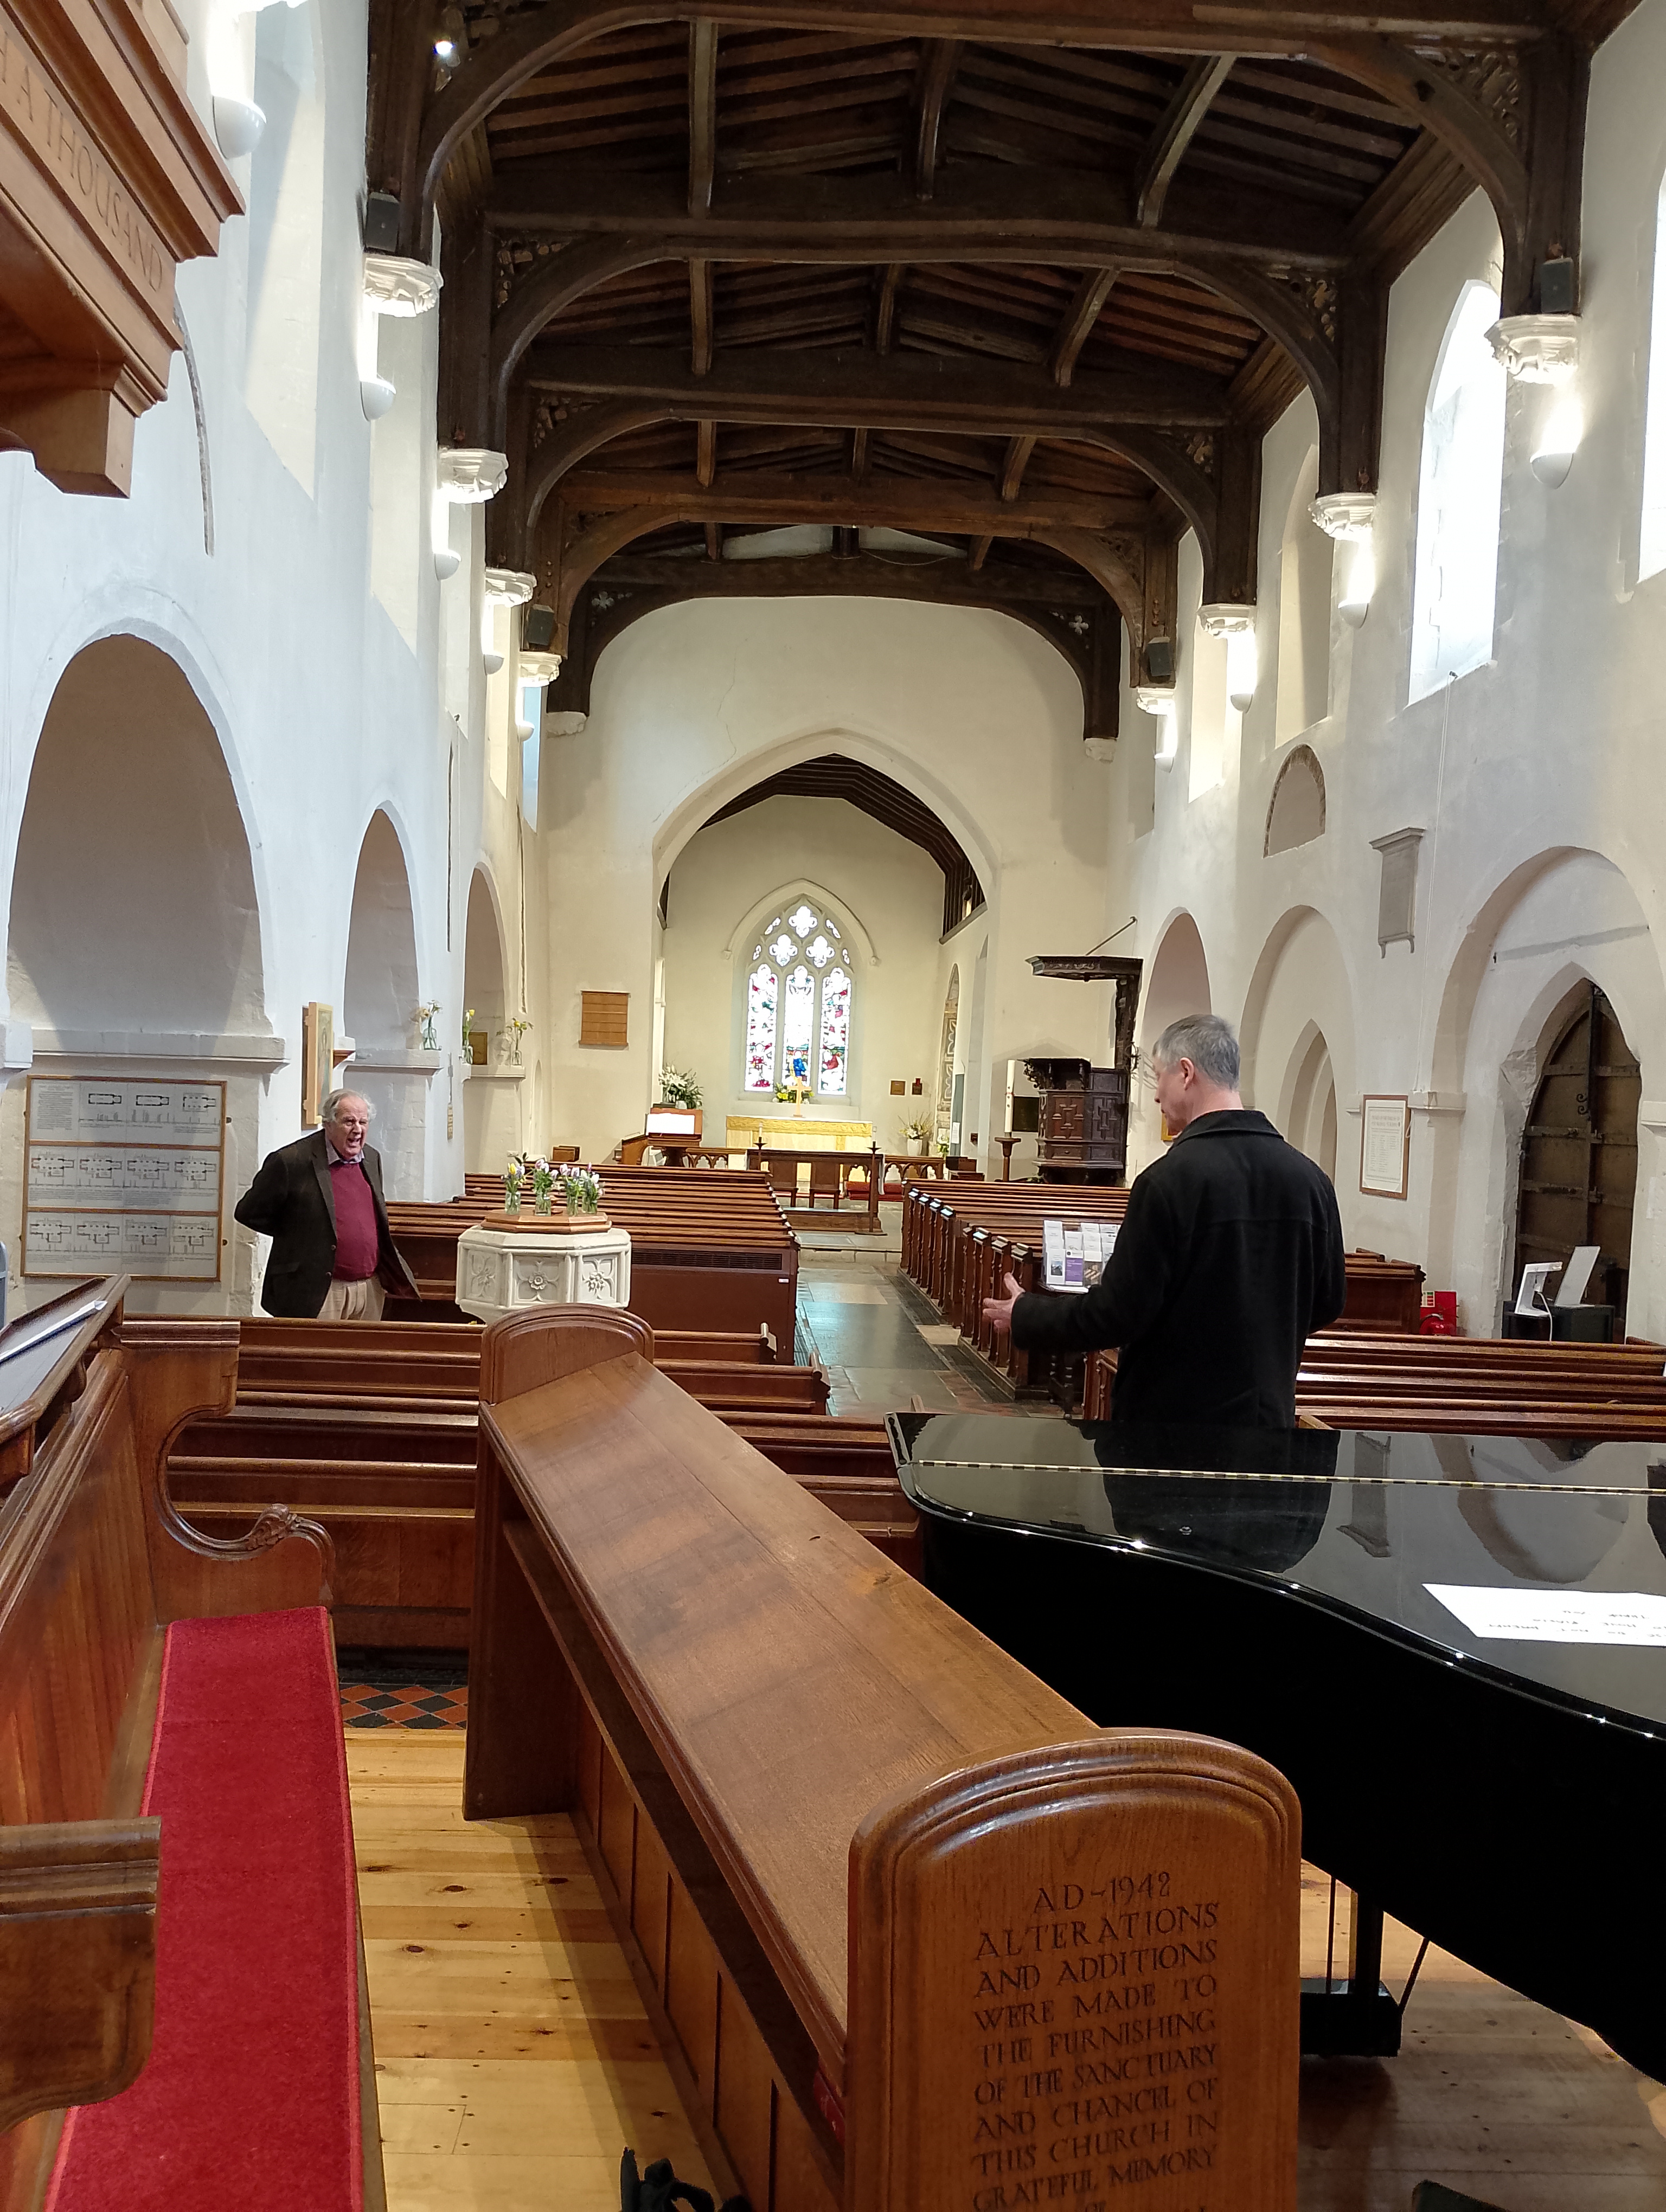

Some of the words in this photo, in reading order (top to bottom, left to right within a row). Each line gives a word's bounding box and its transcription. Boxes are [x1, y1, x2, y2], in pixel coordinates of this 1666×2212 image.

[44, 88, 163, 292] THOUSAND
[975, 1902, 1220, 1960] ALTERATIONS
[975, 1965, 1041, 1998] AND
[1056, 1938, 1218, 1986] ADDITIONS
[974, 1999, 1055, 2031] WERE
[1073, 1982, 1156, 2018] MADE
[1174, 1974, 1217, 2002] TO
[977, 2037, 1033, 2068] THE
[1047, 2008, 1216, 2058] FURNISHING
[973, 2078, 1007, 2106] OF
[1017, 2068, 1063, 2098] THE
[1072, 2043, 1218, 2089] SANCTUARY
[973, 2111, 1036, 2143] AND
[1053, 2085, 1176, 2128] CHANCEL
[1186, 2077, 1218, 2103] OF
[971, 2143, 1037, 2177] THIS
[1049, 2119, 1170, 2163] CHURCH
[1187, 2112, 1218, 2137] IN
[972, 2169, 1098, 2212] GRATEFUL
[1107, 2143, 1218, 2187] MEMORY
